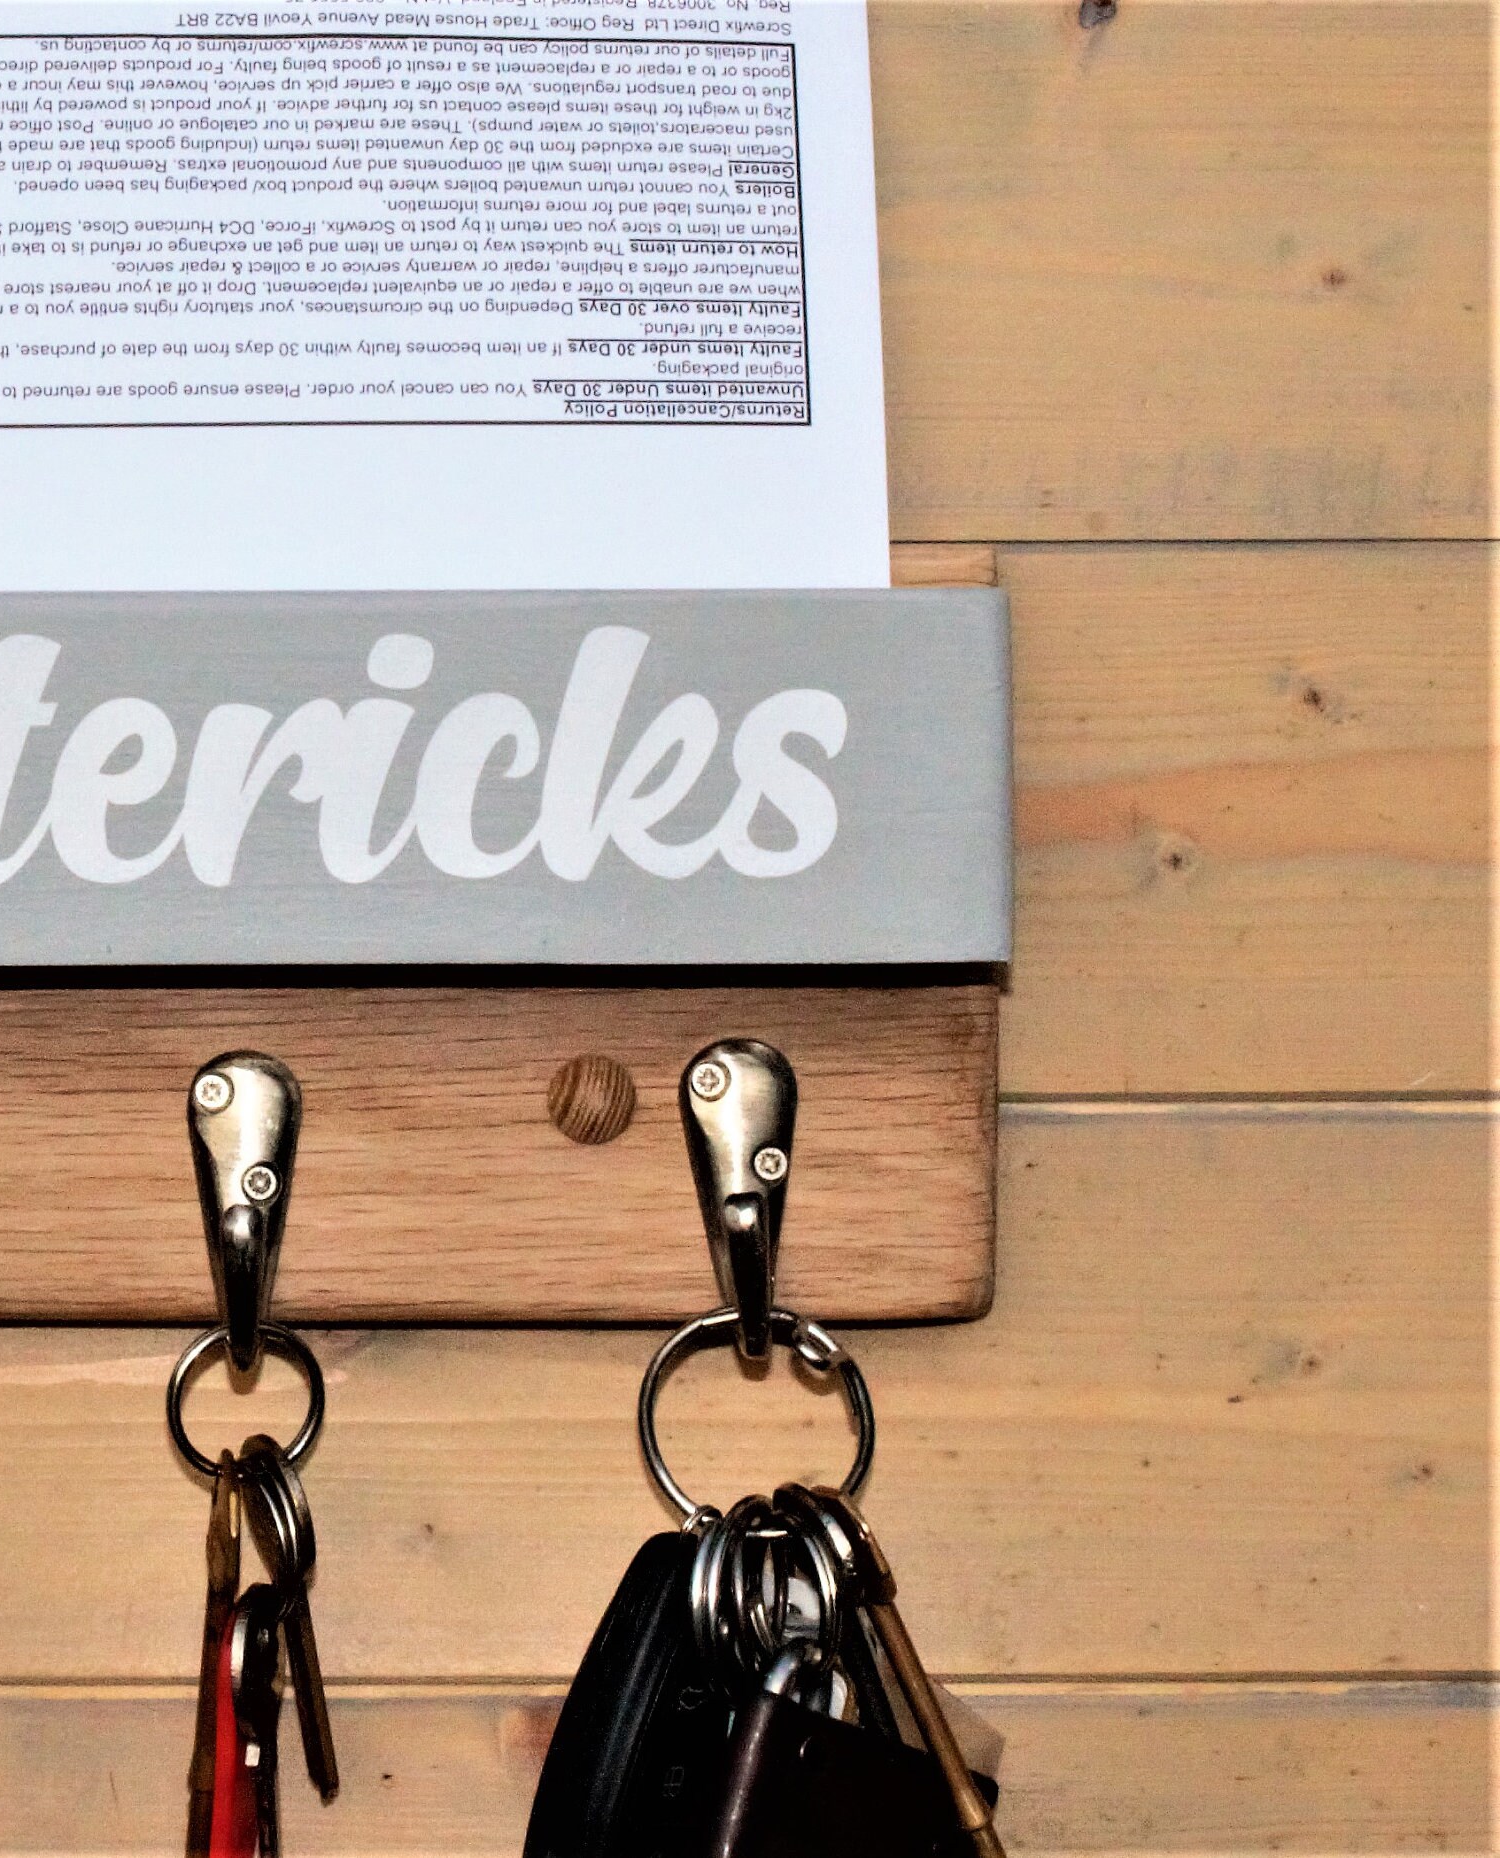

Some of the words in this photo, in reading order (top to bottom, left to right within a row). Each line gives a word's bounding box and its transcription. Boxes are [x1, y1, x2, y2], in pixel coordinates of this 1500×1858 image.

[175, 13, 210, 30] 8RT
[215, 13, 259, 29] BA22
[264, 12, 313, 28] Yeovil
[318, 12, 380, 28] Avenue
[385, 13, 430, 29] Mead
[435, 14, 488, 30] House
[493, 15, 539, 32] Trade
[545, 16, 597, 33] Office:
[602, 15, 635, 34] Reg
[644, 19, 669, 35] Ltd
[674, 19, 720, 36] Direct
[725, 20, 792, 36] Screwfix
[35, 39, 59, 52] us.
[64, 36, 147, 55] contacting
[151, 36, 171, 55] by
[175, 40, 192, 52] or
[413, 41, 428, 57] at
[433, 41, 479, 57] found
[483, 42, 504, 57] be
[509, 42, 538, 55] can
[543, 39, 589, 59] policy
[594, 43, 650, 60] returns
[654, 45, 681, 58] our
[685, 45, 700, 61] of
[705, 46, 757, 63] details
[760, 48, 790, 64] Full
[11, 160, 53, 176] drain
[57, 160, 72, 174] to
[77, 159, 167, 176] Remember
[173, 159, 227, 174] extras.
[232, 156, 328, 175] promotional
[332, 156, 362, 172] any
[367, 159, 398, 175] and
[403, 156, 503, 174] components
[508, 160, 526, 176] all
[531, 160, 564, 176] with
[568, 161, 612, 177] items
[617, 161, 664, 176] return
[668, 162, 723, 179] Please
[728, 163, 795, 180] General
[14, 177, 80, 195] opened.
[84, 180, 125, 195] been
[130, 180, 160, 195] has
[164, 176, 248, 195] packaging
[292, 176, 353, 195] product
[358, 179, 384, 195] the
[389, 179, 440, 195] where
[444, 180, 498, 196] boilers
[503, 180, 583, 196] unwanted
[587, 181, 635, 196] return
[639, 182, 693, 197] cannot
[698, 183, 730, 199] You
[735, 184, 796, 201] Boilers
[111, 261, 174, 277] service.
[179, 258, 226, 277] repair
[232, 261, 243, 277] &
[248, 261, 301, 277] collect
[306, 261, 316, 274] a
[320, 261, 338, 274] or
[342, 261, 401, 277] service
[405, 258, 477, 275] warranty
[482, 261, 499, 274] or
[503, 258, 551, 277] repair
[556, 259, 623, 278] helpline,
[628, 262, 638, 275] a
[643, 262, 689, 279] offers
[693, 263, 800, 280] manufacturer
[9, 304, 19, 316] a
[24, 303, 40, 318] to
[45, 300, 75, 316] you
[79, 302, 129, 319] entitle
[133, 299, 179, 318] rights
[183, 299, 254, 316] statutory
[259, 298, 295, 314] your
[300, 299, 423, 317] circumstances,
[428, 301, 454, 317] the
[459, 301, 480, 314] on
[485, 298, 574, 317] Depending
[579, 299, 622, 318] Days
[627, 302, 647, 318] 30
[653, 302, 690, 315] over
[696, 303, 743, 319] Items
[748, 300, 801, 320] Faulty
[639, 323, 695, 339] refund.
[700, 324, 724, 339] full
[728, 324, 738, 336] a
[743, 324, 802, 340] receive
[16, 341, 96, 360] purchase,
[101, 344, 117, 360] of
[122, 343, 158, 359] date
[162, 343, 188, 359] the
[193, 343, 230, 359] from
[235, 340, 274, 358] days
[278, 342, 300, 358] 30
[305, 342, 352, 358] within
[356, 339, 402, 358] faulty
[406, 342, 481, 358] becomes
[487, 342, 522, 358] item
[526, 342, 548, 355] an
[552, 342, 562, 358] If
[568, 339, 611, 358] Days
[617, 342, 637, 358] 30
[641, 343, 691, 359] under
[697, 343, 744, 359] Items
[750, 341, 803, 360] Faulty
[652, 360, 740, 379] packaging.
[745, 361, 804, 379] original
[2, 386, 17, 401] to
[23, 385, 91, 402] returned
[96, 385, 123, 398] are
[128, 382, 178, 401] goods
[183, 384, 240, 397] ensure
[244, 384, 301, 400] Please
[307, 383, 355, 399] order.
[359, 380, 396, 396] your
[401, 383, 455, 399] cancel
[460, 383, 489, 395] can
[495, 383, 527, 398] You
[533, 380, 577, 398] Days
[582, 383, 602, 399] 30
[607, 383, 659, 399] Under
[665, 383, 712, 399] items
[718, 384, 805, 400] Unwanted
[564, 401, 618, 420] Policy
[624, 404, 805, 421] Returns/Cancellation
